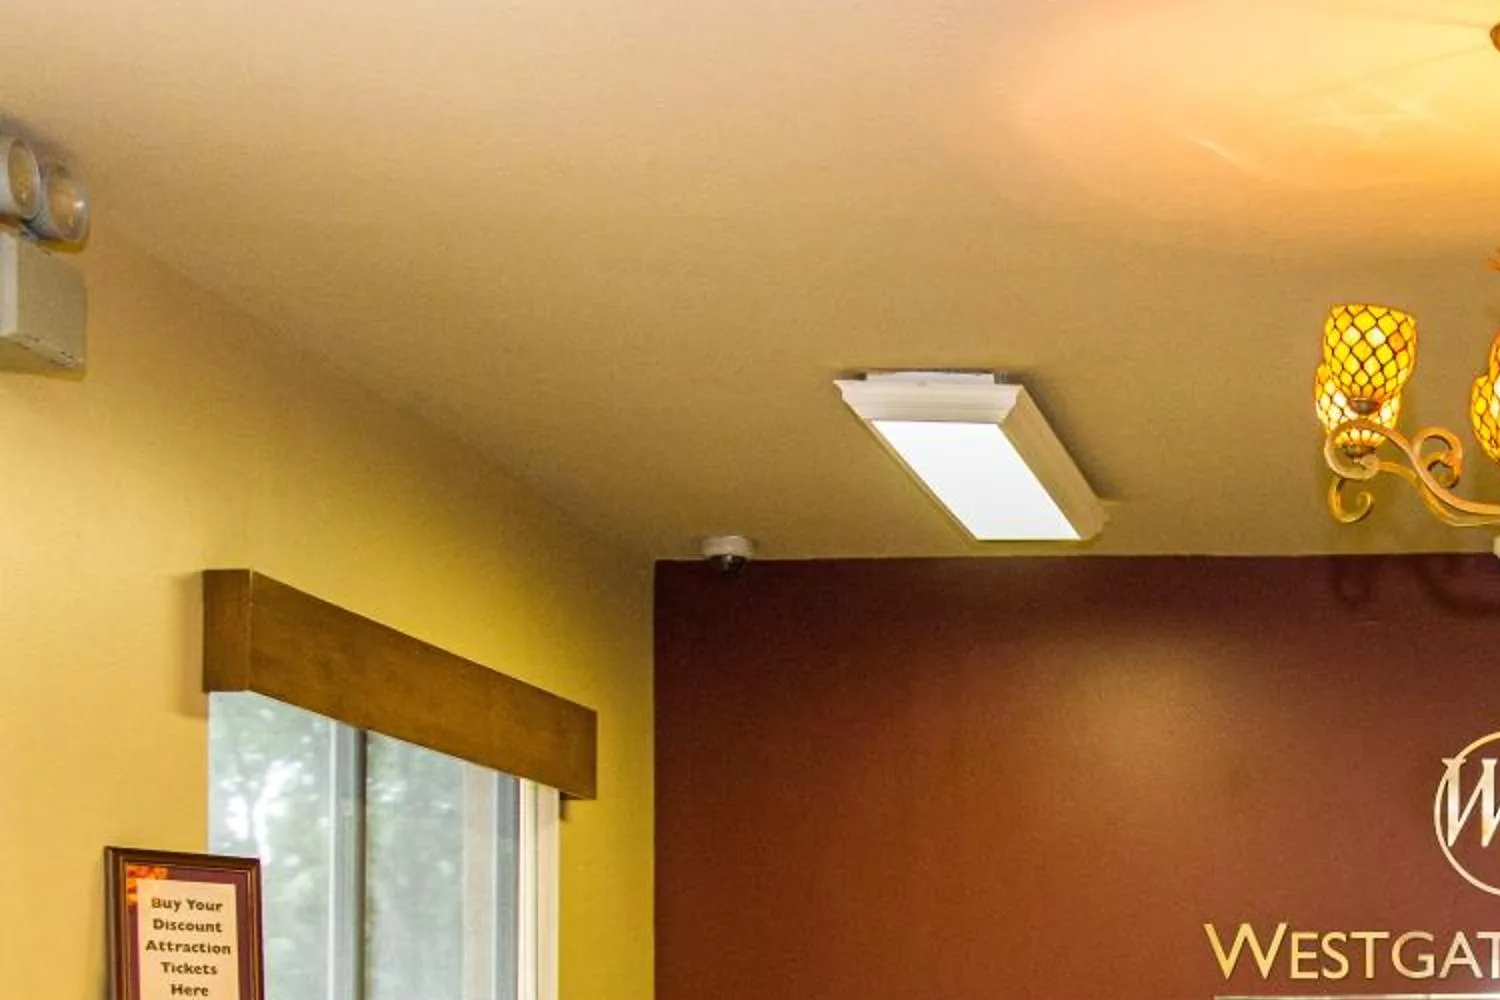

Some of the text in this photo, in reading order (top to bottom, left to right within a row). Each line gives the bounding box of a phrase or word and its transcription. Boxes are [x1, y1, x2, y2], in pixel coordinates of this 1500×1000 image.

[151, 897, 223, 912] Buy Your
[152, 918, 223, 933] Discount
[145, 940, 231, 955] Attraction
[160, 961, 218, 975] Tickets
[170, 983, 209, 997] Here
